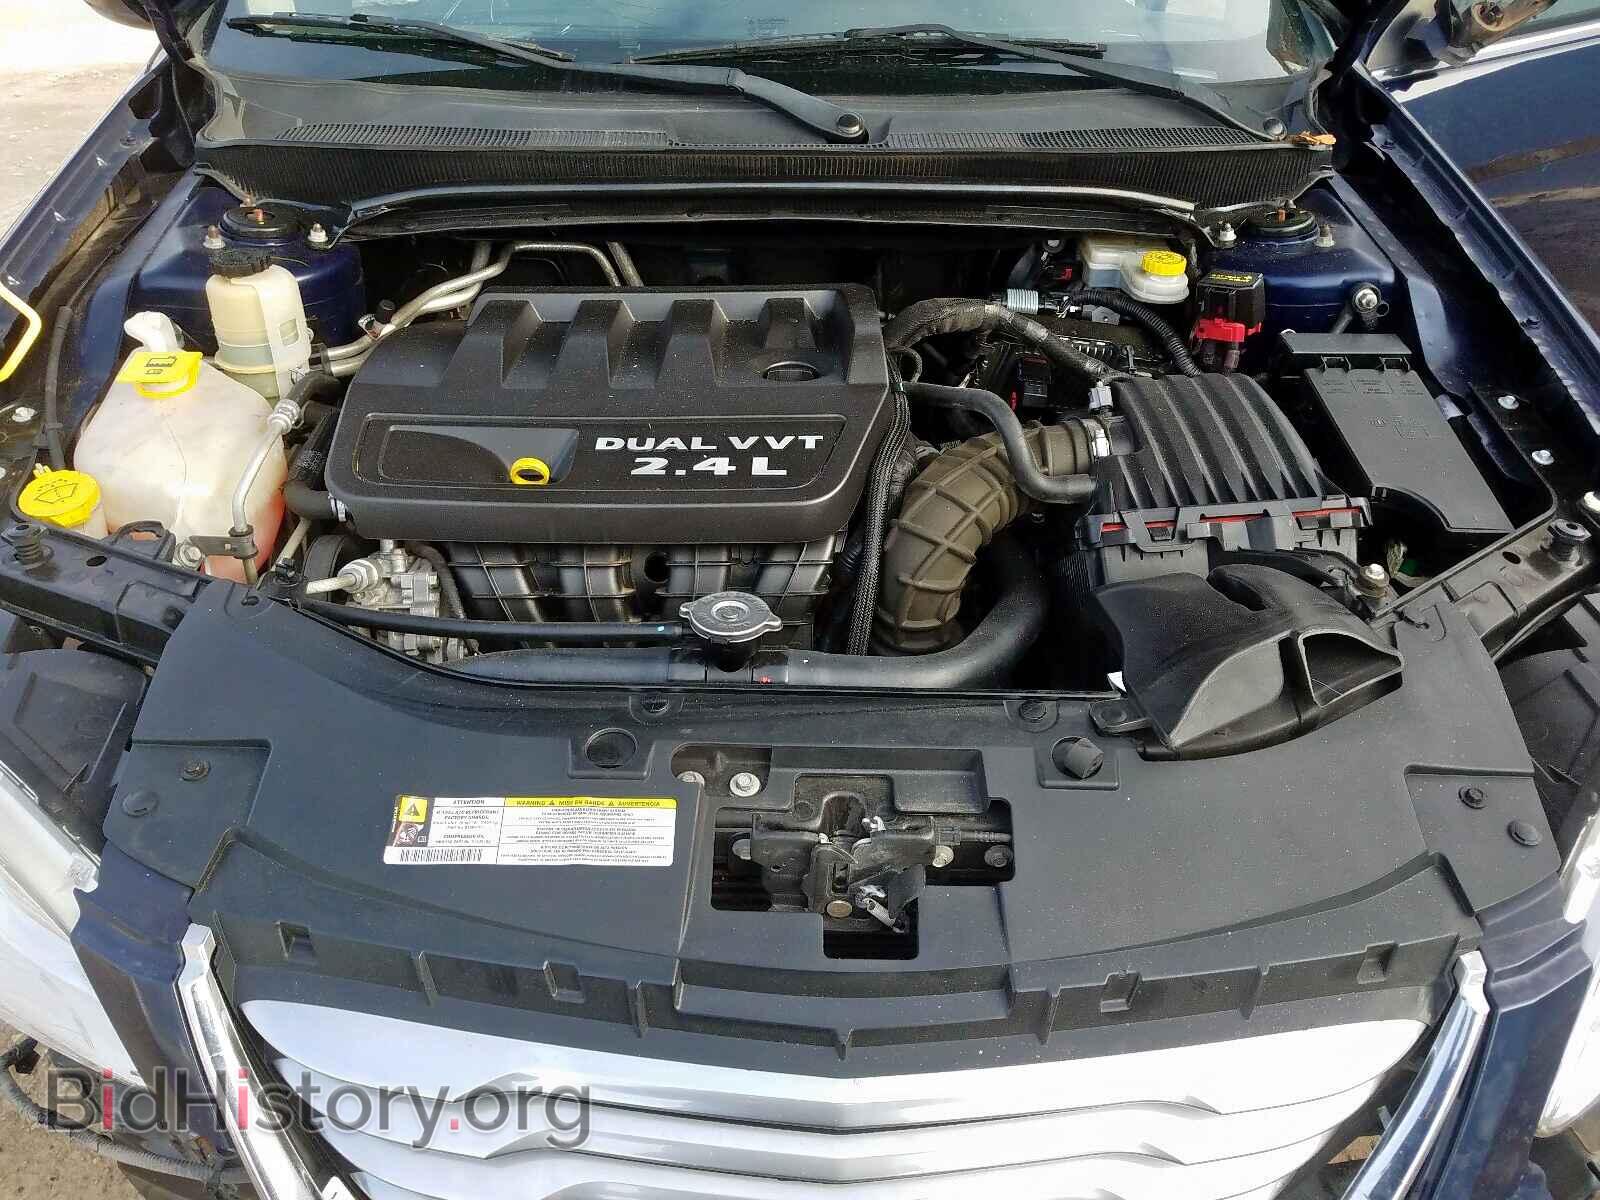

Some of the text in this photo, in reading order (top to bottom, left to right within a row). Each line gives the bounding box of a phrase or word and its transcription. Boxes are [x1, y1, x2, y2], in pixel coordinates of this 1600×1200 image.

[595, 435, 824, 450] DUAL VVT
[630, 456, 788, 476] 2.4 L
